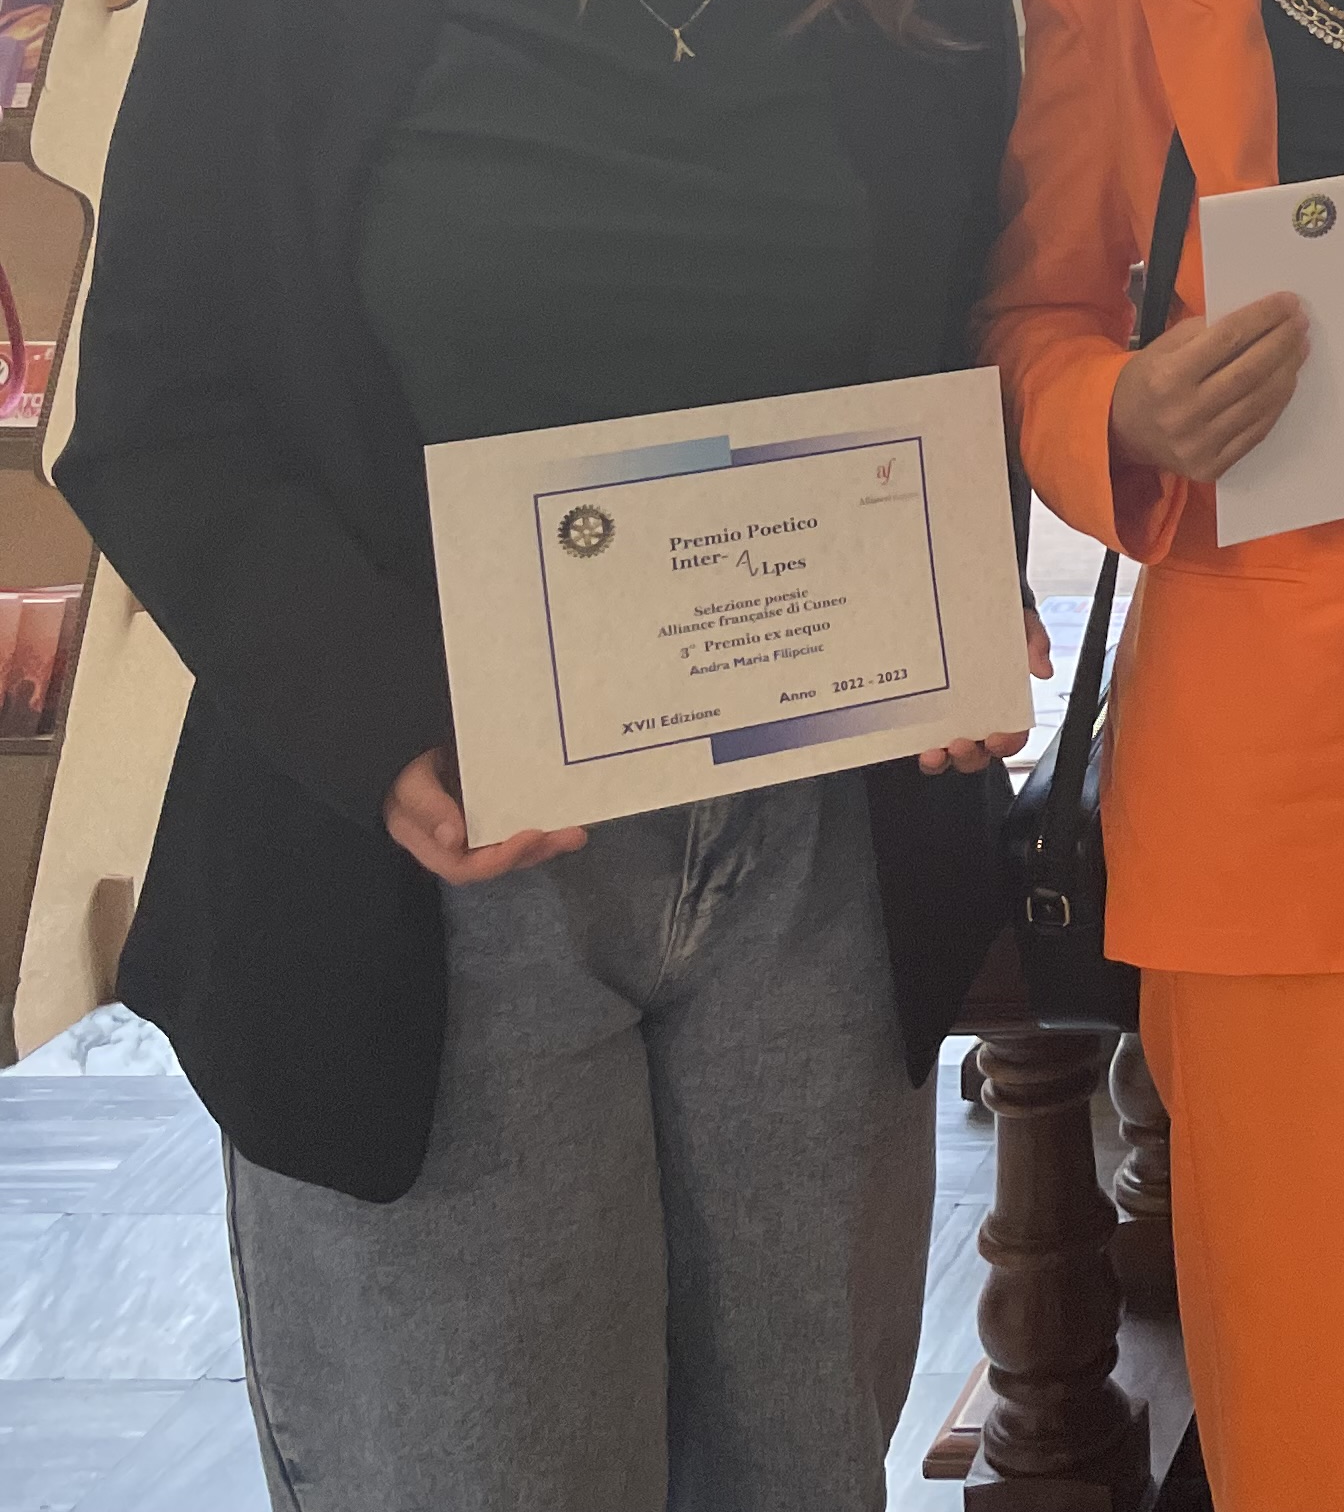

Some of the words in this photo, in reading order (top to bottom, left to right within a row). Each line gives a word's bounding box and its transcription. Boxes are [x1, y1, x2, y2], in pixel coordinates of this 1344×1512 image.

[669, 527, 741, 551] Premio
[748, 515, 818, 542] Poetico
[657, 617, 714, 639] Alliance
[718, 606, 782, 629] française
[787, 602, 799, 616] di
[803, 595, 847, 612] Cuneo
[694, 595, 760, 618] Selezione
[764, 587, 808, 611] poesie
[704, 633, 761, 653] Premio
[765, 631, 781, 643] ex
[785, 620, 831, 642] aequo
[733, 654, 769, 669] Maria
[779, 688, 816, 703] Anno
[832, 676, 864, 692] 2022
[877, 669, 908, 685] 2023
[622, 718, 655, 734] XVII
[660, 707, 721, 728] Edizione
